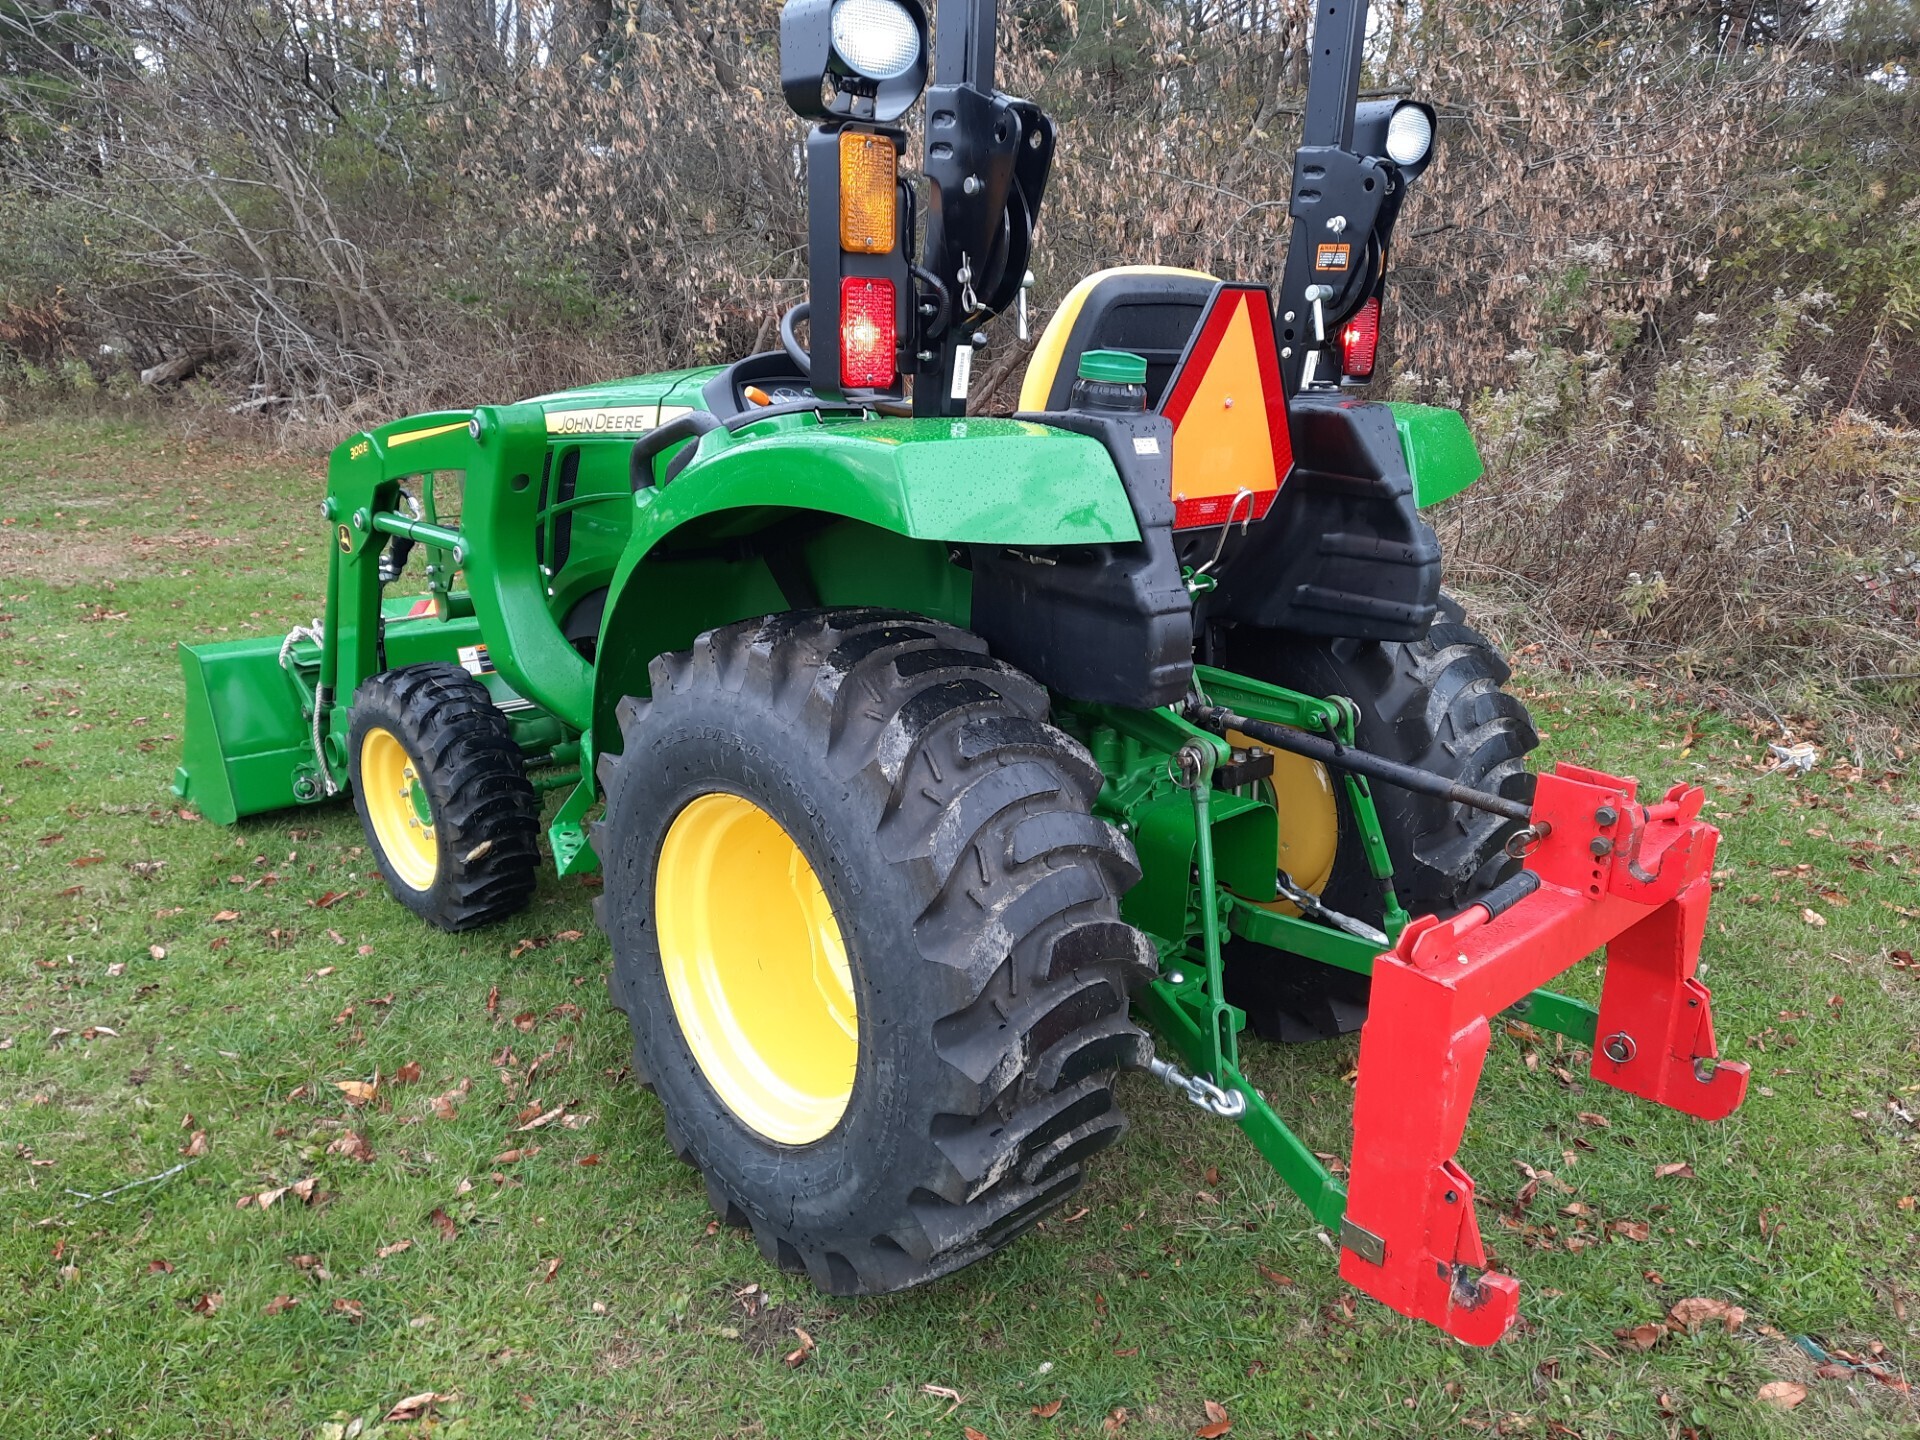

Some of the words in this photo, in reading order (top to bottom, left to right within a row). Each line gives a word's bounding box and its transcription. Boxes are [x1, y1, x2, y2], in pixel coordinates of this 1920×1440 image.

[558, 415, 593, 431] JOHN
[595, 413, 644, 429] DEERE
[349, 441, 368, 460] 300E
